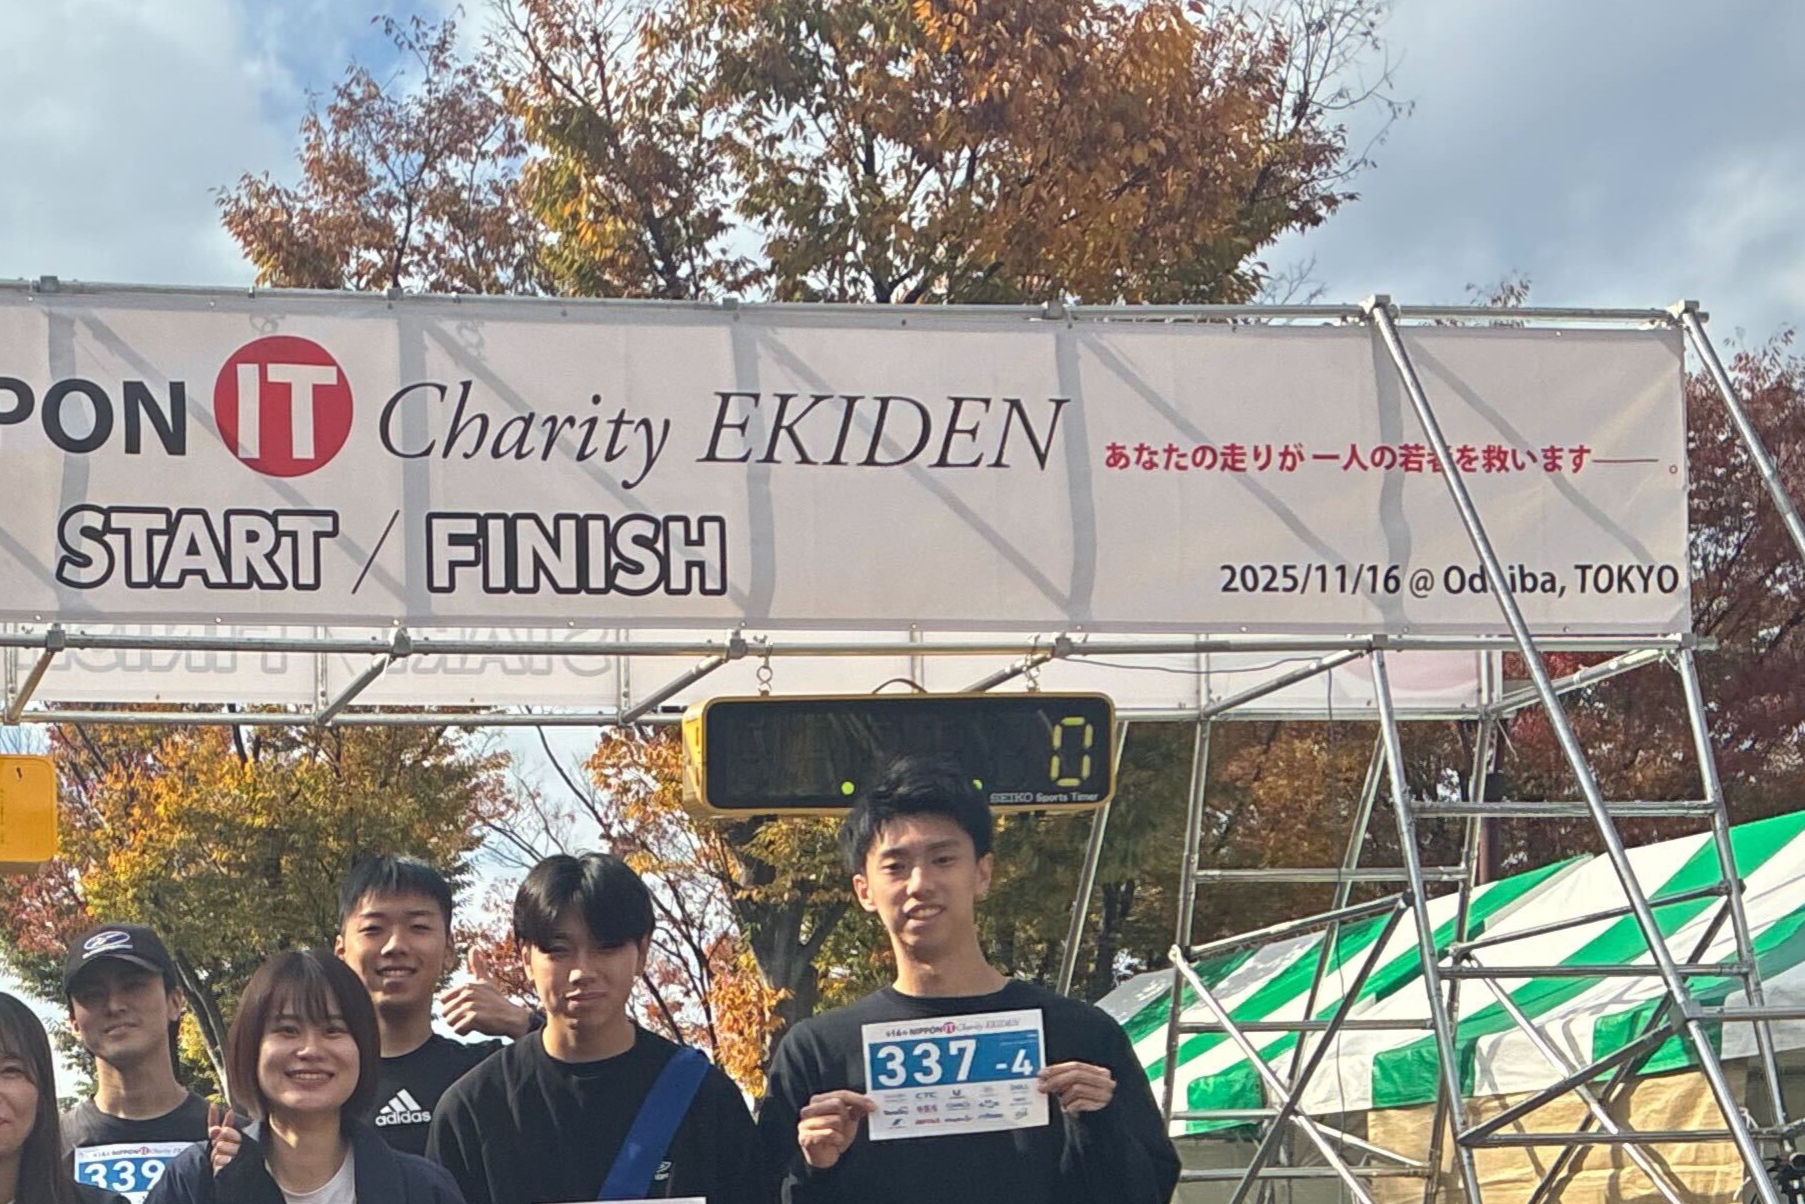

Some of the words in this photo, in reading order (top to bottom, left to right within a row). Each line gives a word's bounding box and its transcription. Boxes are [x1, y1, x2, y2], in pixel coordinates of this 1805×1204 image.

[231, 356, 343, 467] IT
[379, 379, 672, 490] Charity
[696, 391, 1071, 471] EKIDEN
[56, 504, 339, 591] START
[352, 509, 400, 594] /
[426, 511, 727, 596] FINISH
[1220, 563, 1400, 595] 2025/11/16
[1408, 568, 1434, 598] @
[1443, 564, 1566, 598] Odiba,
[1574, 564, 1679, 595] TOKYO
[989, 792, 1033, 803] SEIKO
[1036, 792, 1068, 803] Sports
[1071, 791, 1099, 801] Timer
[877, 1039, 976, 1087] 337
[996, 1049, 1033, 1076] -4
[375, 1110, 431, 1127] adidas
[85, 1159, 165, 1192] 339
